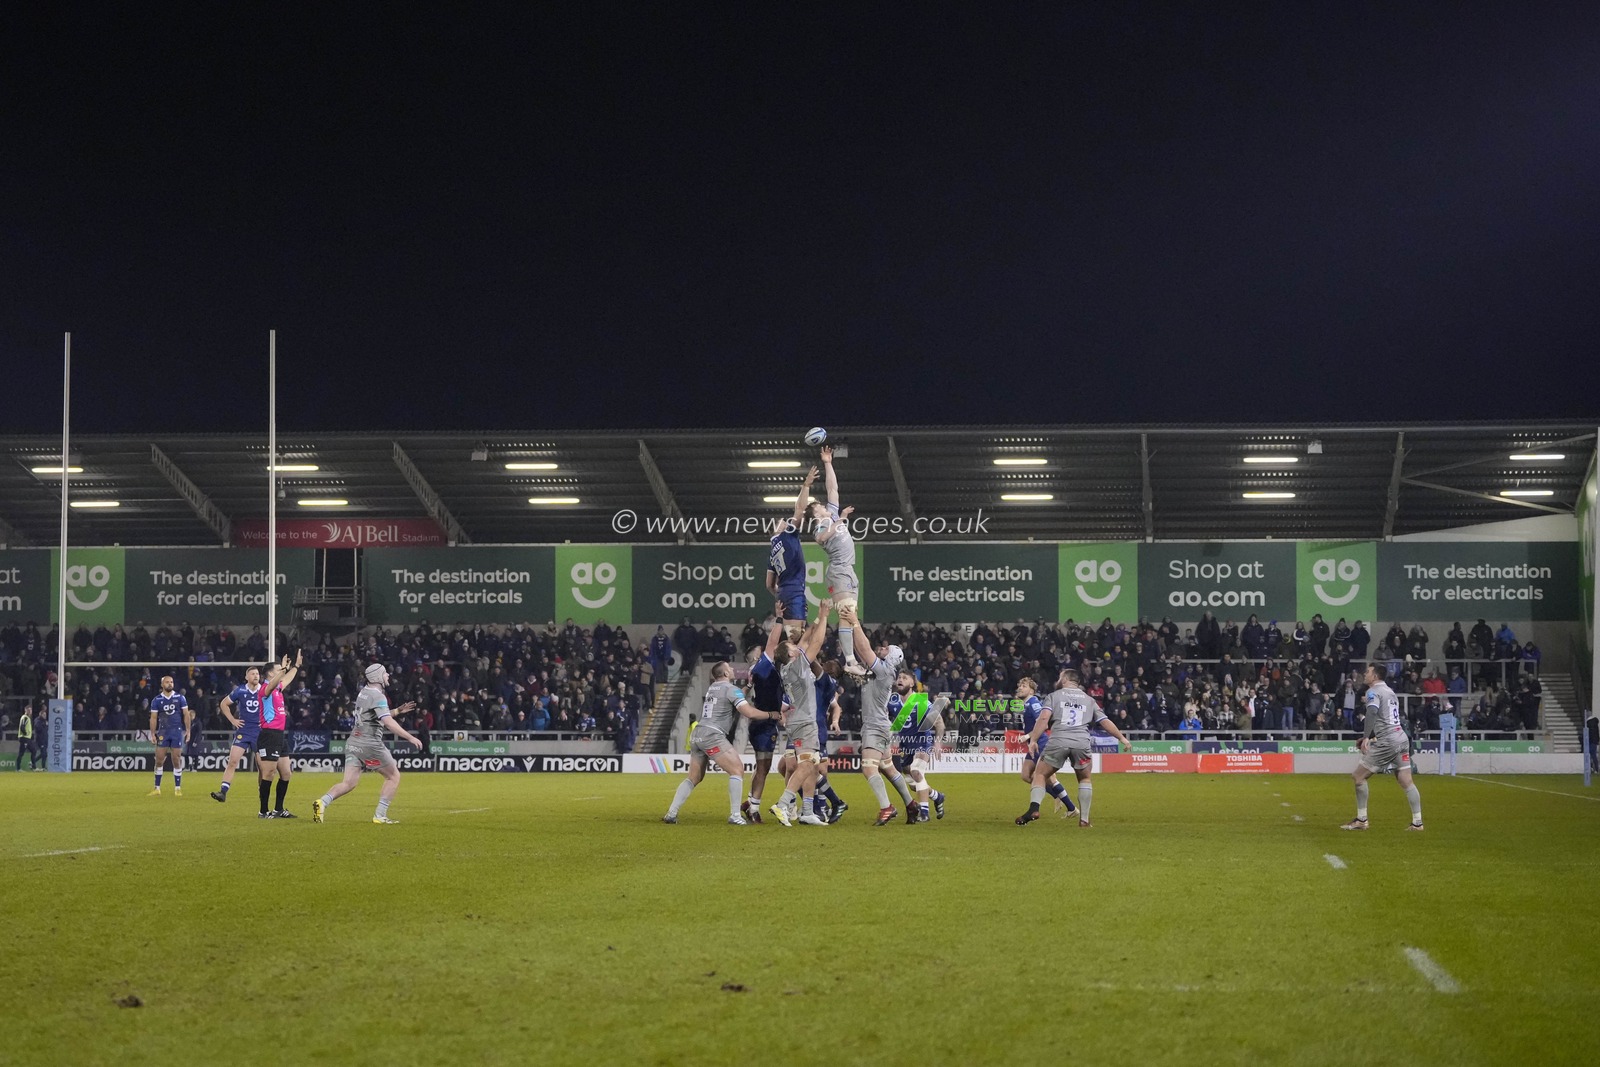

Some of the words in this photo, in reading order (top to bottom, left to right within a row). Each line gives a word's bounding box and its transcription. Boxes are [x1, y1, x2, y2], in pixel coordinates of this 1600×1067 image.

[289, 531, 300, 540] to
[302, 530, 318, 540] the
[341, 526, 364, 546] AJ
[366, 525, 399, 542] Bell
[402, 533, 440, 543] Stadium
[66, 565, 110, 587] ao
[392, 569, 425, 583] The
[429, 569, 530, 583] destination
[571, 563, 617, 584] ao
[662, 562, 725, 585] Shop
[729, 563, 755, 581] at
[890, 567, 924, 581] The
[928, 566, 1033, 581] destination
[1075, 560, 1122, 582] ao
[1169, 560, 1231, 583] Shop
[1238, 561, 1264, 578] at
[1313, 559, 1361, 581] ao
[1404, 565, 1439, 579] The
[1443, 564, 1551, 579] destination
[150, 571, 183, 585] The
[157, 591, 183, 605] for
[399, 590, 425, 604] for
[429, 590, 522, 604] electricals
[662, 590, 755, 608] ao.com
[897, 588, 925, 602] for
[929, 587, 1025, 602] electricals
[1169, 591, 1265, 606] ao.com
[1412, 585, 1440, 600] for
[1445, 585, 1544, 600] electricals
[303, 610, 319, 620] SHOT
[52, 716, 63, 767] Gallagher
[72, 756, 147, 770] macron
[440, 757, 515, 771] macron
[543, 757, 619, 771] macron
